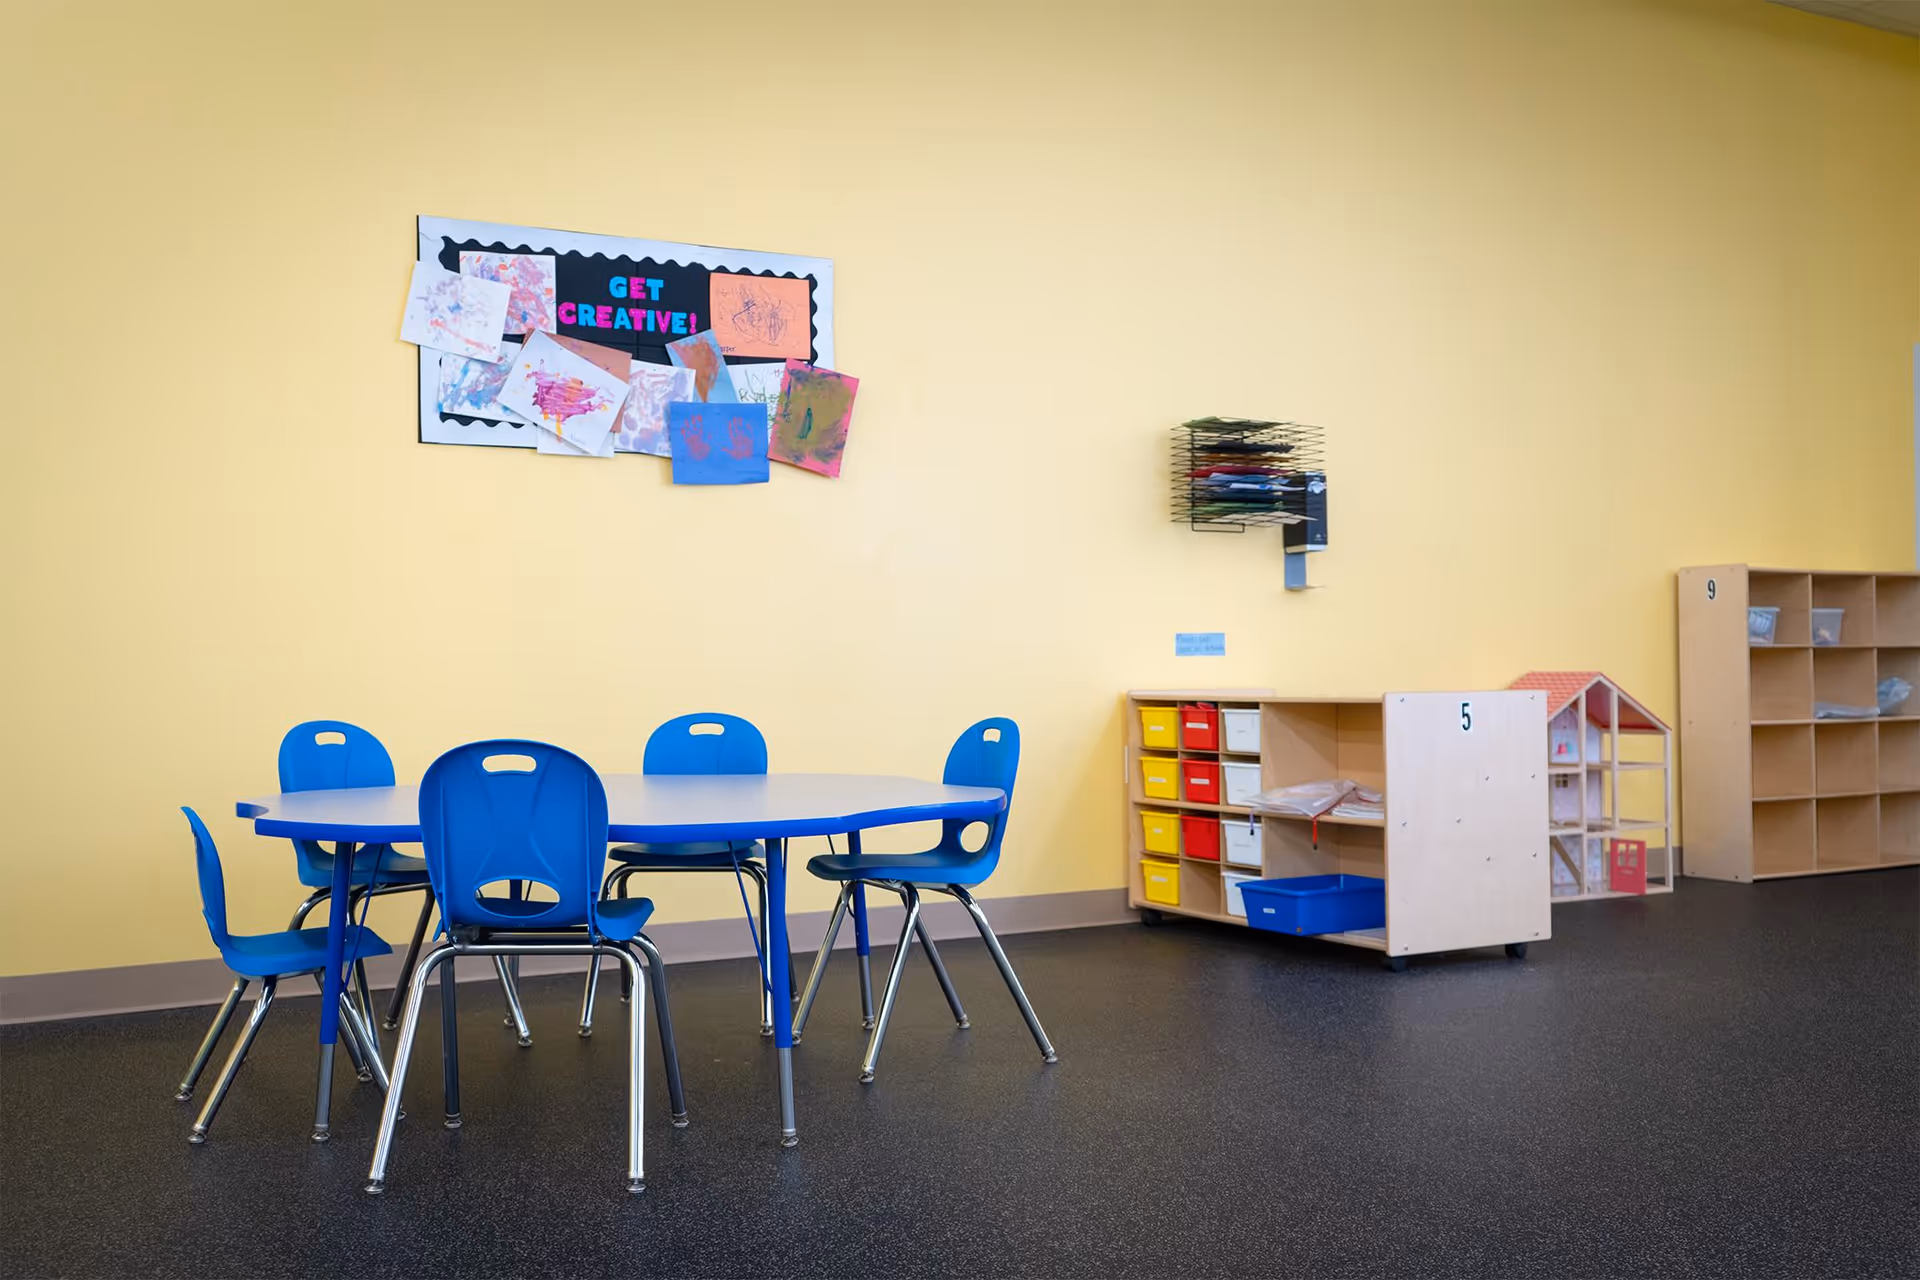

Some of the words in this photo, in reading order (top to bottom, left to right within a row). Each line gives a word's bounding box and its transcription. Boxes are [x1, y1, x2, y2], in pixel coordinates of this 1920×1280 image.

[609, 276, 664, 300] GET
[558, 302, 697, 334] CREATIVE!
[1707, 579, 1716, 600] 9
[1461, 702, 1471, 731] 5
